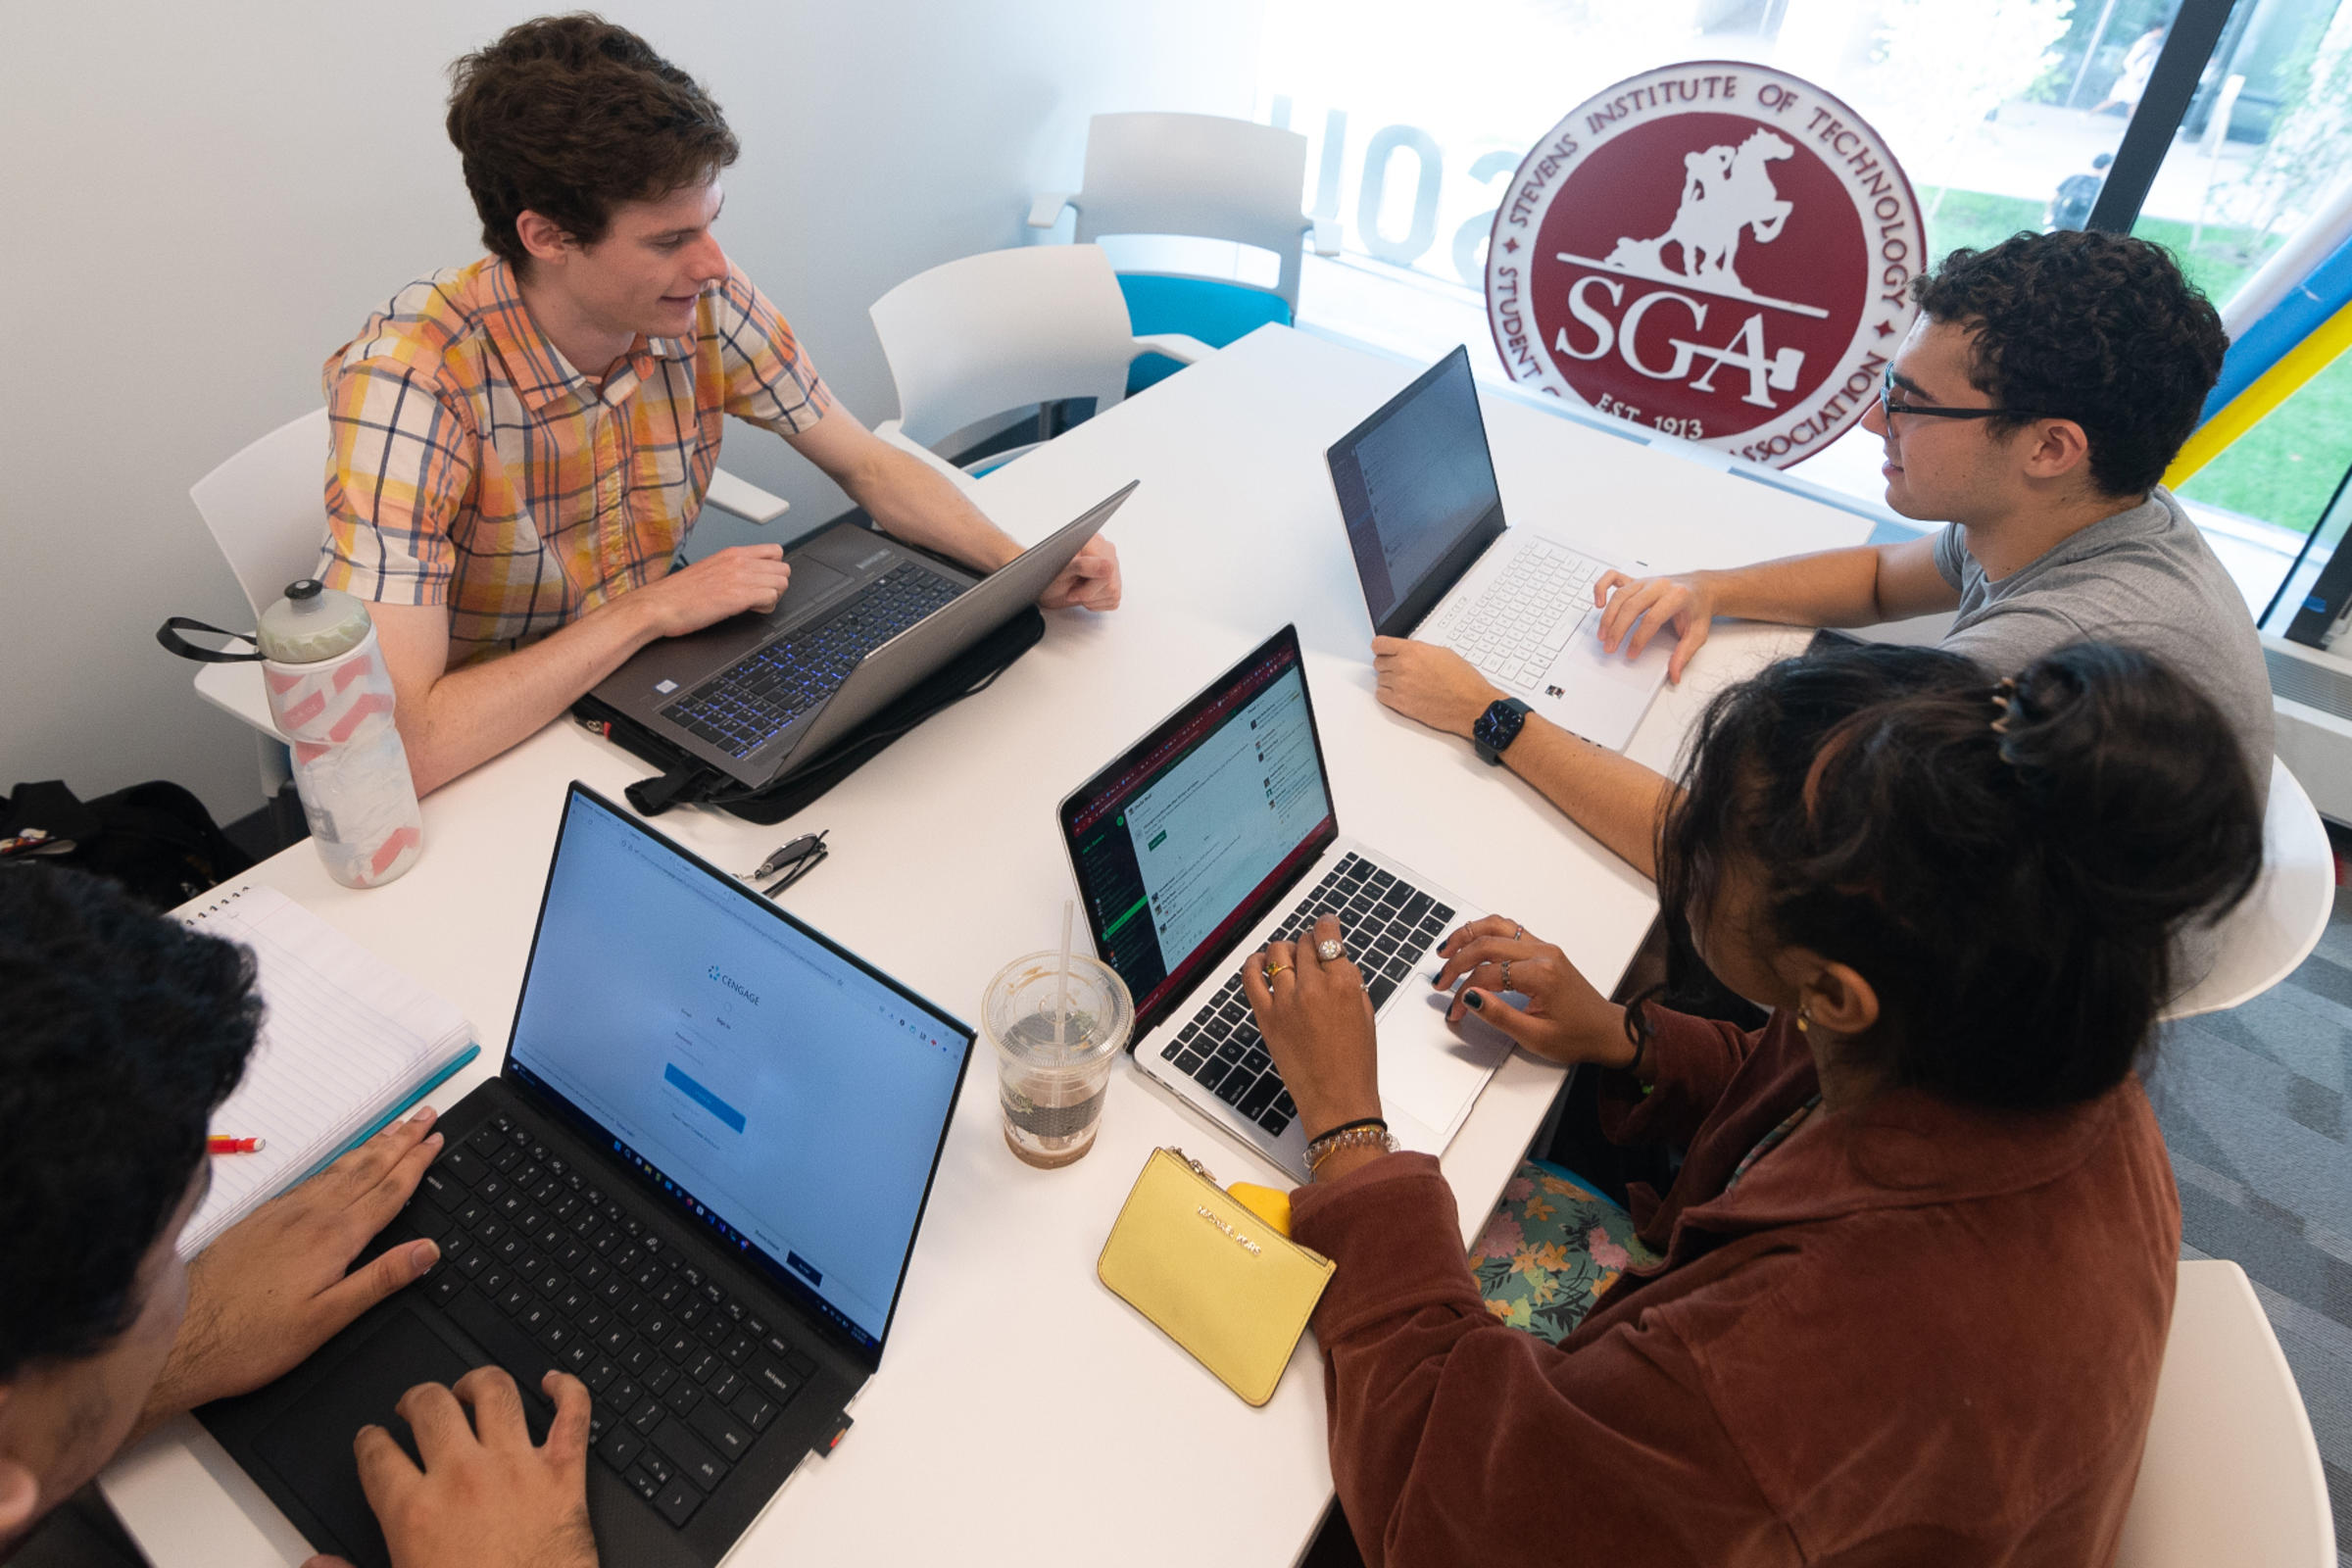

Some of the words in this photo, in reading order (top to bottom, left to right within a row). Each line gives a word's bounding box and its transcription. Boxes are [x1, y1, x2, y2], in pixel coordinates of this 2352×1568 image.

[1509, 133, 1579, 228] STEVENS
[1586, 75, 1738, 135] INSTITUTE
[1757, 83, 1799, 113] OF
[1807, 106, 1909, 310] TECHNOLOGY
[1497, 267, 1543, 379] STUDENT
[1555, 275, 1778, 410] SGA
[1654, 415, 1704, 440] 1913
[1729, 350, 1888, 462] SSOCIATION
[721, 974, 760, 1006] CENGAGE
